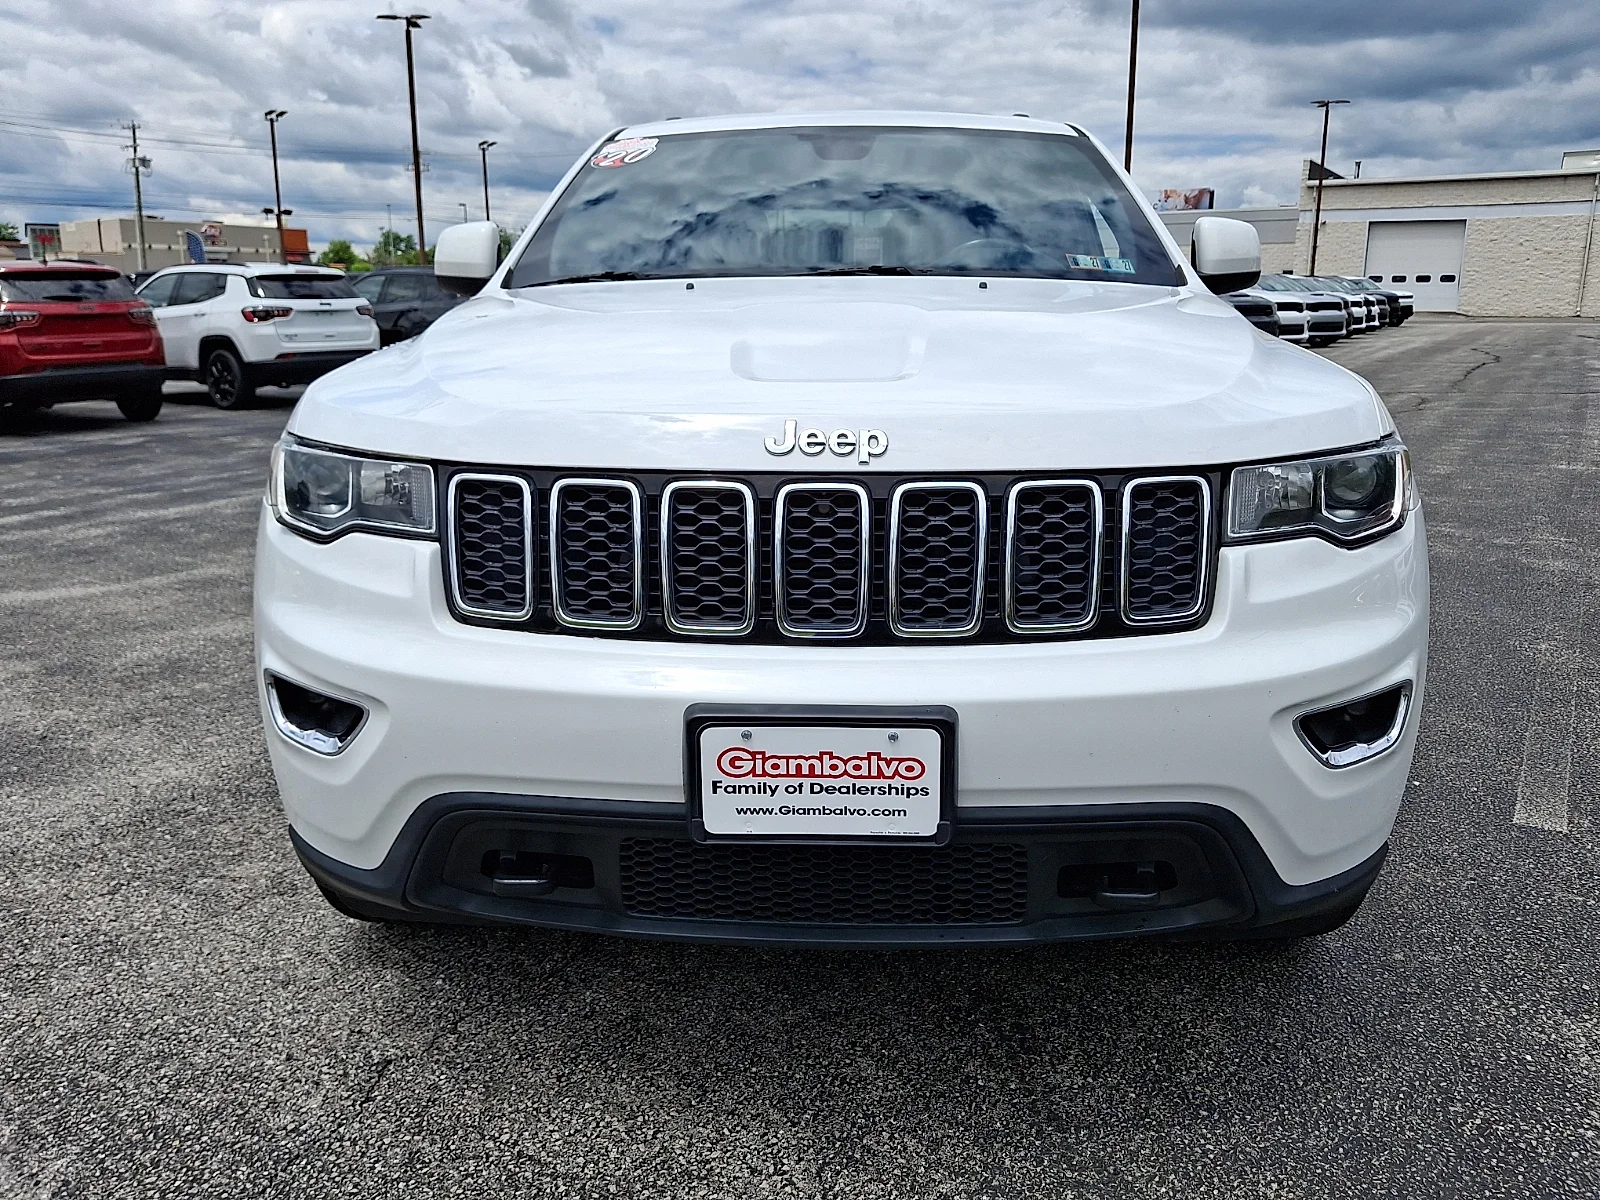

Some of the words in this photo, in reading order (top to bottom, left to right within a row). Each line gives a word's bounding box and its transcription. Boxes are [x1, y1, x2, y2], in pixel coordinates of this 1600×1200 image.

[763, 419, 889, 465] Jeep
[716, 746, 927, 781] Giambalvo
[711, 780, 780, 797] Family
[784, 781, 804, 795] of
[809, 782, 930, 798] Dealerships
[735, 805, 907, 818] www.Giambalvo.com
